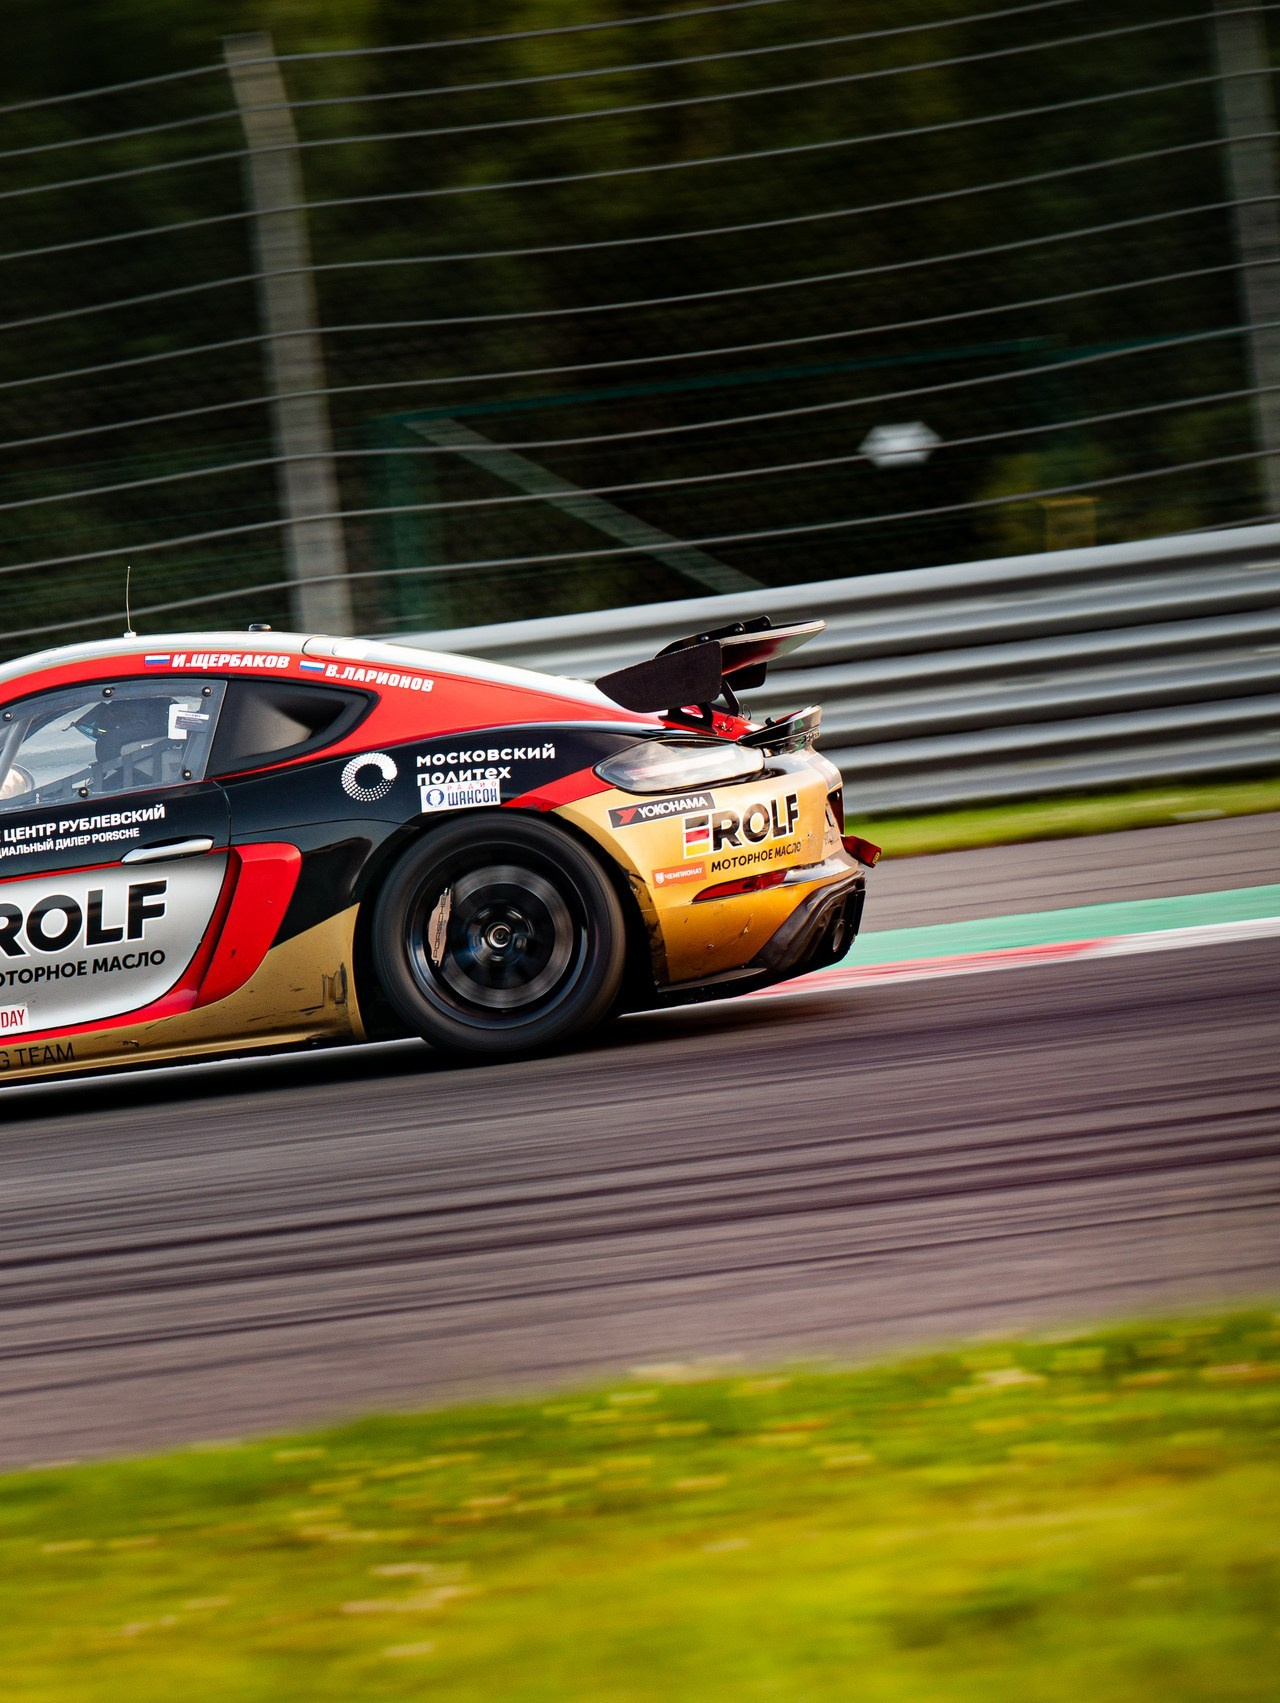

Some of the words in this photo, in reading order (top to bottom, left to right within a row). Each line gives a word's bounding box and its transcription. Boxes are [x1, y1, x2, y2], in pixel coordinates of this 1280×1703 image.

[171, 654, 290, 669] И.ЩЕРБАКОВ
[325, 664, 435, 692] В.ЛАРИОНОВ
[447, 781, 497, 791] РАДИО
[447, 788, 497, 806] ШАНСОН
[638, 796, 708, 818] YOKOHAMA
[4, 823, 56, 842] ЦЕНТР
[59, 803, 166, 835] РУБЛЕВСКИЙ
[712, 793, 799, 851] ROLF
[55, 834, 91, 851] ДИЛЕР
[92, 827, 140, 844] PORSCHE
[774, 841, 801, 859] МАСЛО
[711, 848, 773, 873] МОТОРНОЕ
[664, 867, 703, 879] ЧЕМПИОНАТ
[433, 895, 447, 958] PORSCHE
[92, 950, 166, 974] МАСЛО
[14, 1042, 76, 1068] TEAM
